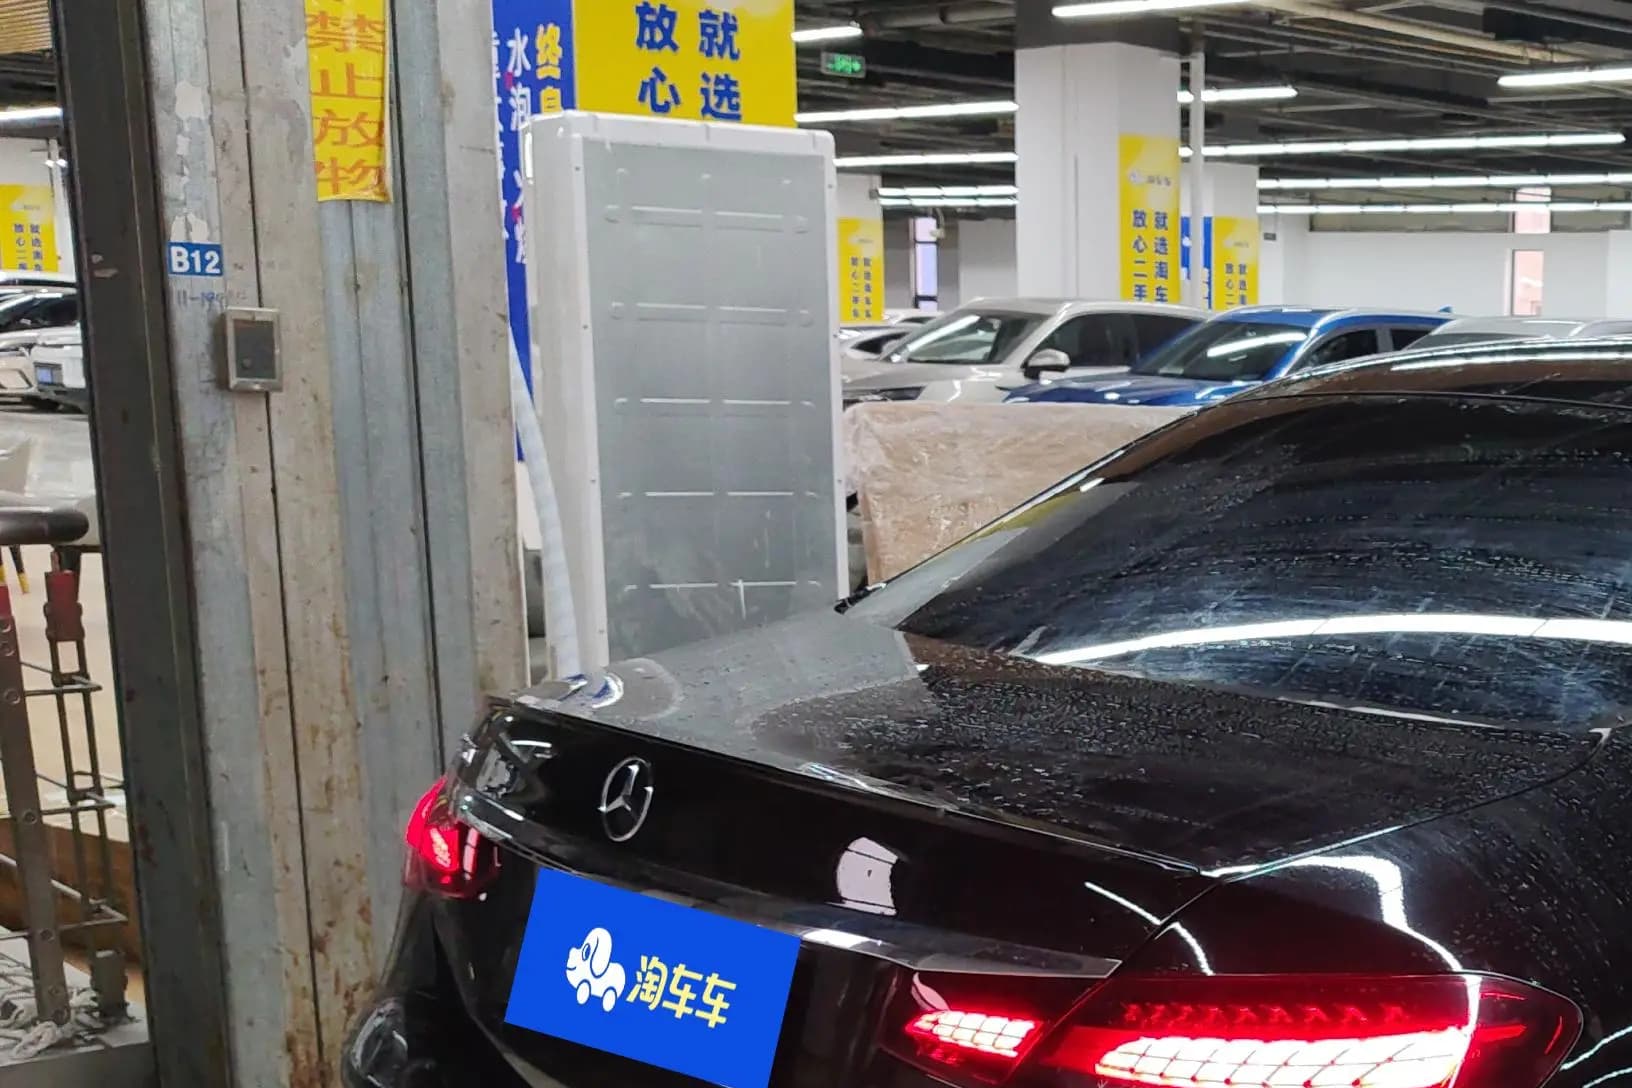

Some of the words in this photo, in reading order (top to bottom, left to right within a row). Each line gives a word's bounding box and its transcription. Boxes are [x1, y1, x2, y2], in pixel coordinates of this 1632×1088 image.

[634, 1, 682, 114] 放心
[698, 9, 742, 121] 就选
[171, 246, 221, 274] B12
